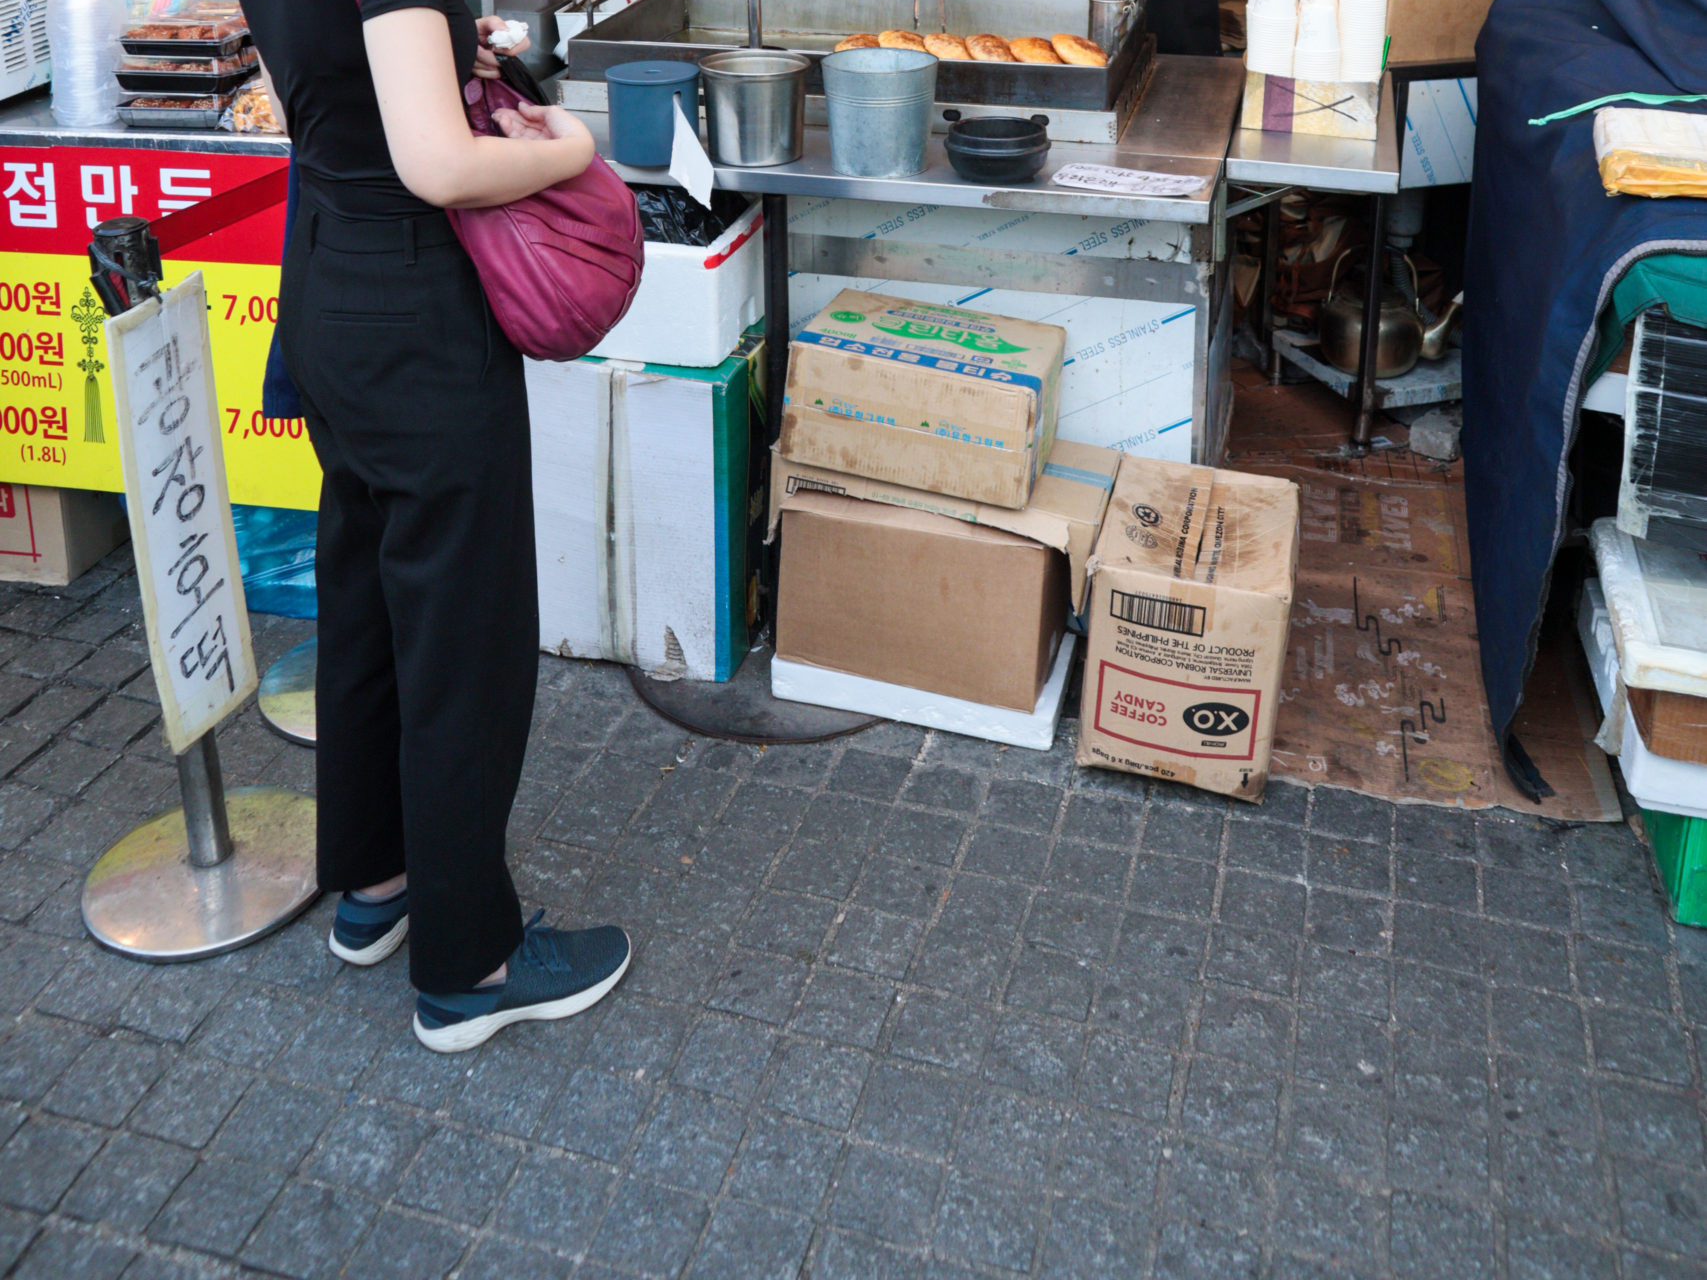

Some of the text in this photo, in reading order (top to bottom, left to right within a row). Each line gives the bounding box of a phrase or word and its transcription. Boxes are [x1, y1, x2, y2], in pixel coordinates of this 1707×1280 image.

[876, 214, 905, 235] STEEL
[1078, 230, 1109, 251] STEEL
[1076, 318, 1160, 361] STAINLESS STEEL
[936, 358, 1013, 383] 물티슈
[0, 405, 68, 441] 00원
[20, 444, 67, 466] (1.8L)
[1116, 625, 1256, 657] PRODUCT OF THE PHILIPPINES
[1114, 645, 1174, 668] CORPORATION
[1174, 660, 1207, 674] ROBINA
[1208, 665, 1253, 677] UNIVERSAL
[1113, 689, 1166, 714] CANDY
[1109, 700, 1168, 727] COFFEE
[1190, 708, 1240, 733] X.O.
[1090, 746, 1110, 762] bags
[1110, 754, 1117, 764] 6
[1160, 768, 1176, 778] 420
